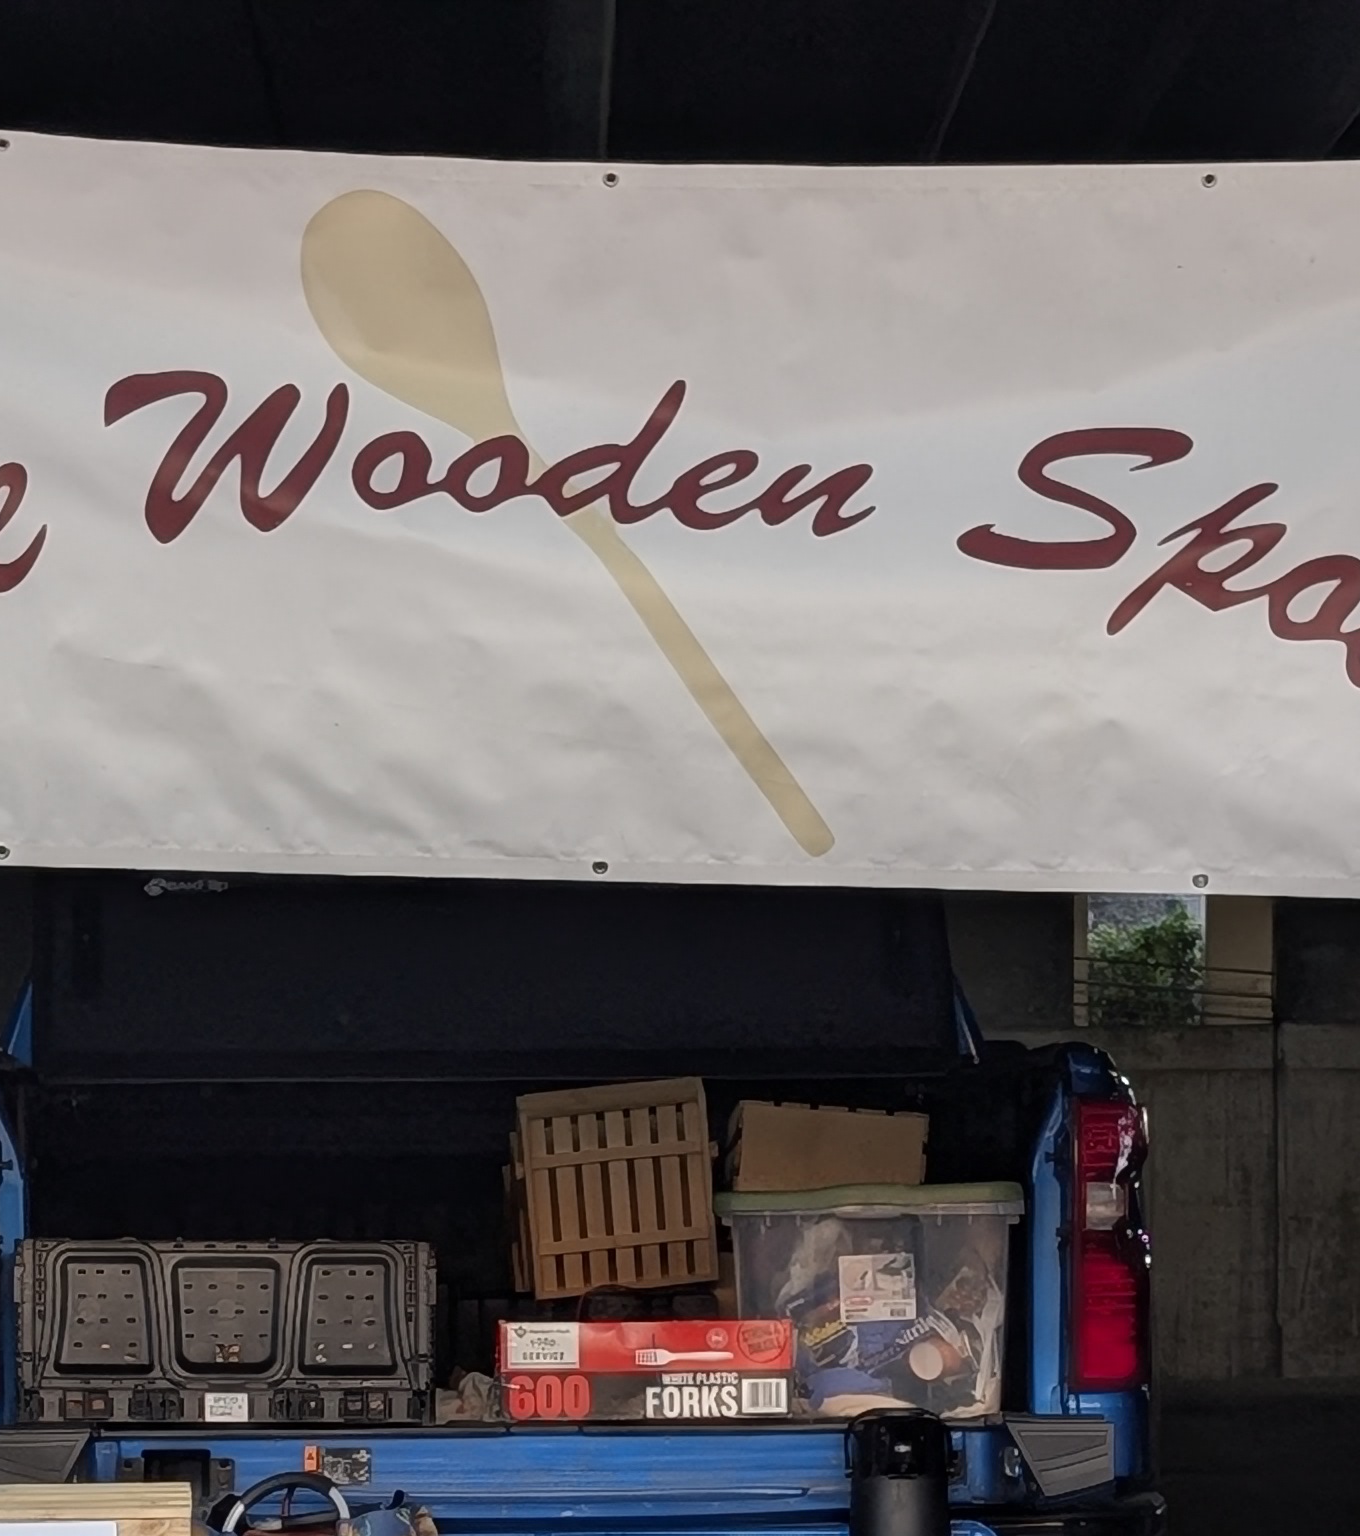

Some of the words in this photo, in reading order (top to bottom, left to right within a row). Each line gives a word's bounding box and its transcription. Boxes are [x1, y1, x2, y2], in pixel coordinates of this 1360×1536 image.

[104, 370, 876, 544] Wooden
[509, 1374, 590, 1420] 600
[696, 1371, 739, 1386] PLASTIC
[645, 1385, 739, 1419] FORKS
